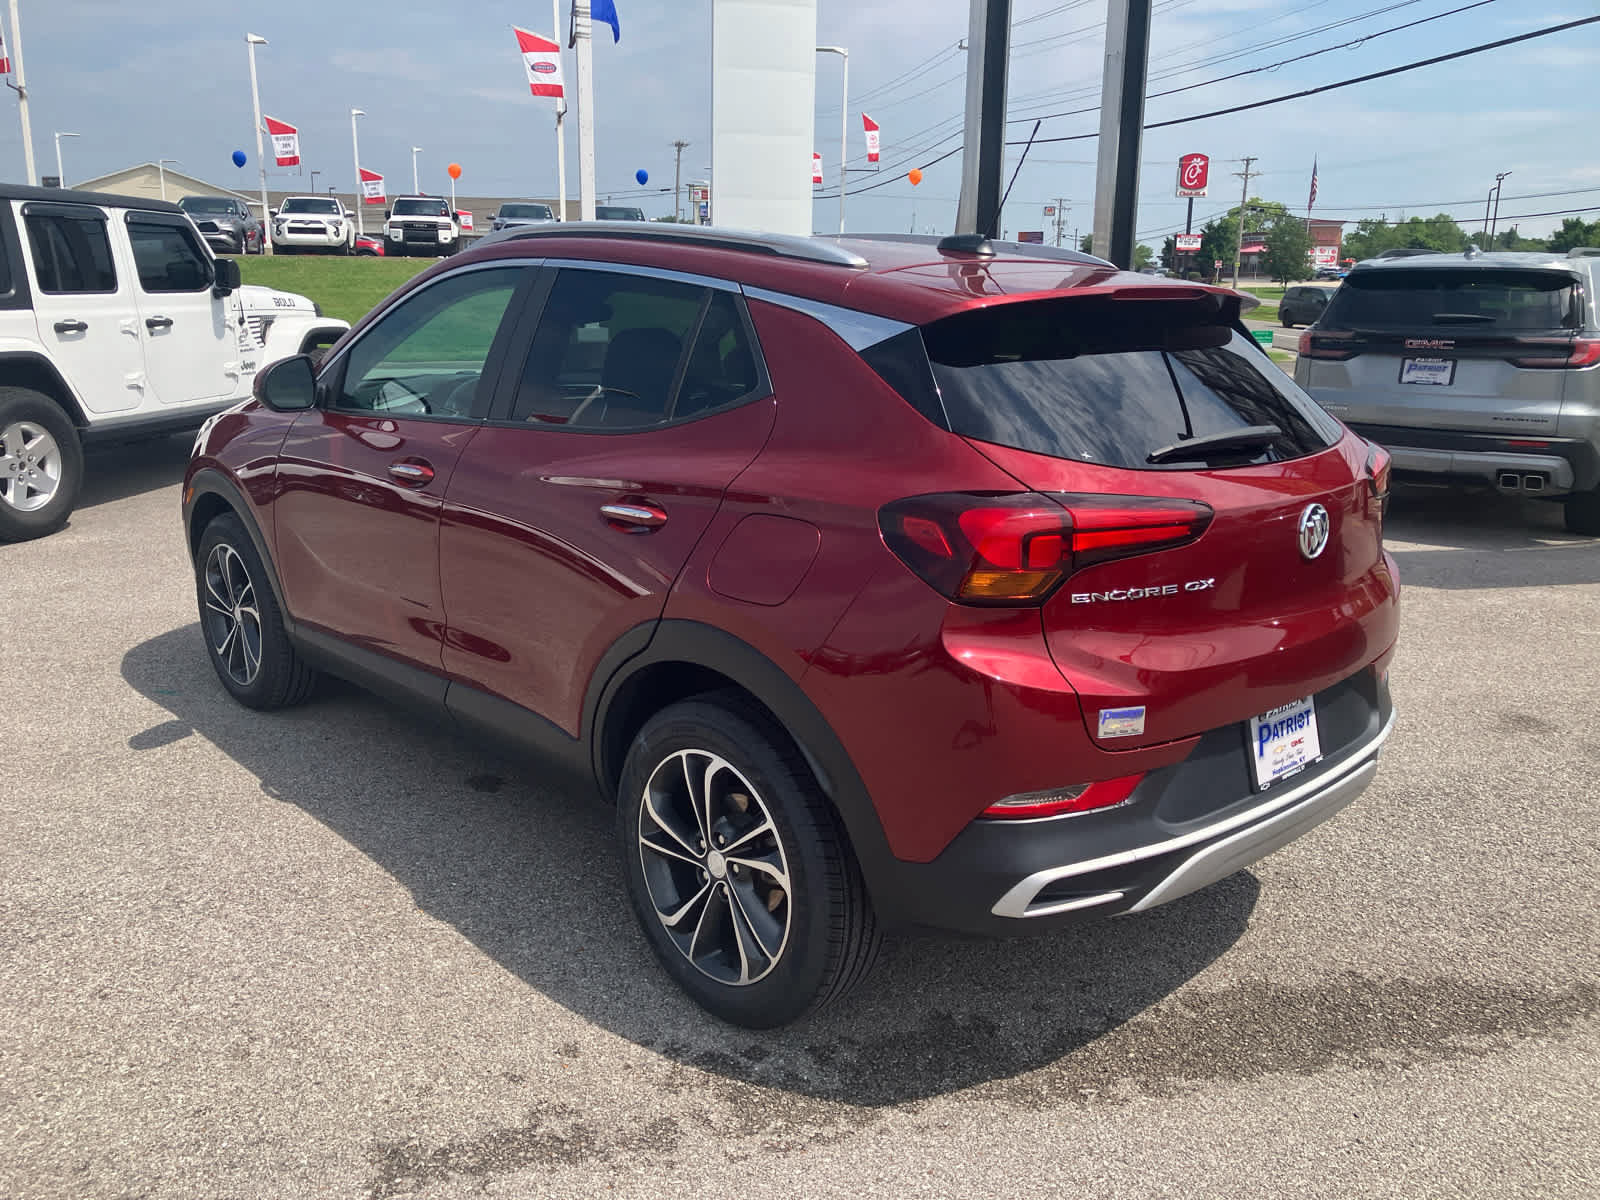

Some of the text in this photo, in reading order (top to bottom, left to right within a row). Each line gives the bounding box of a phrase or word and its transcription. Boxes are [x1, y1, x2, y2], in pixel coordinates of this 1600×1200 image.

[1071, 578, 1215, 604] ENCORE GX
[1258, 709, 1312, 757] PATRIOT
